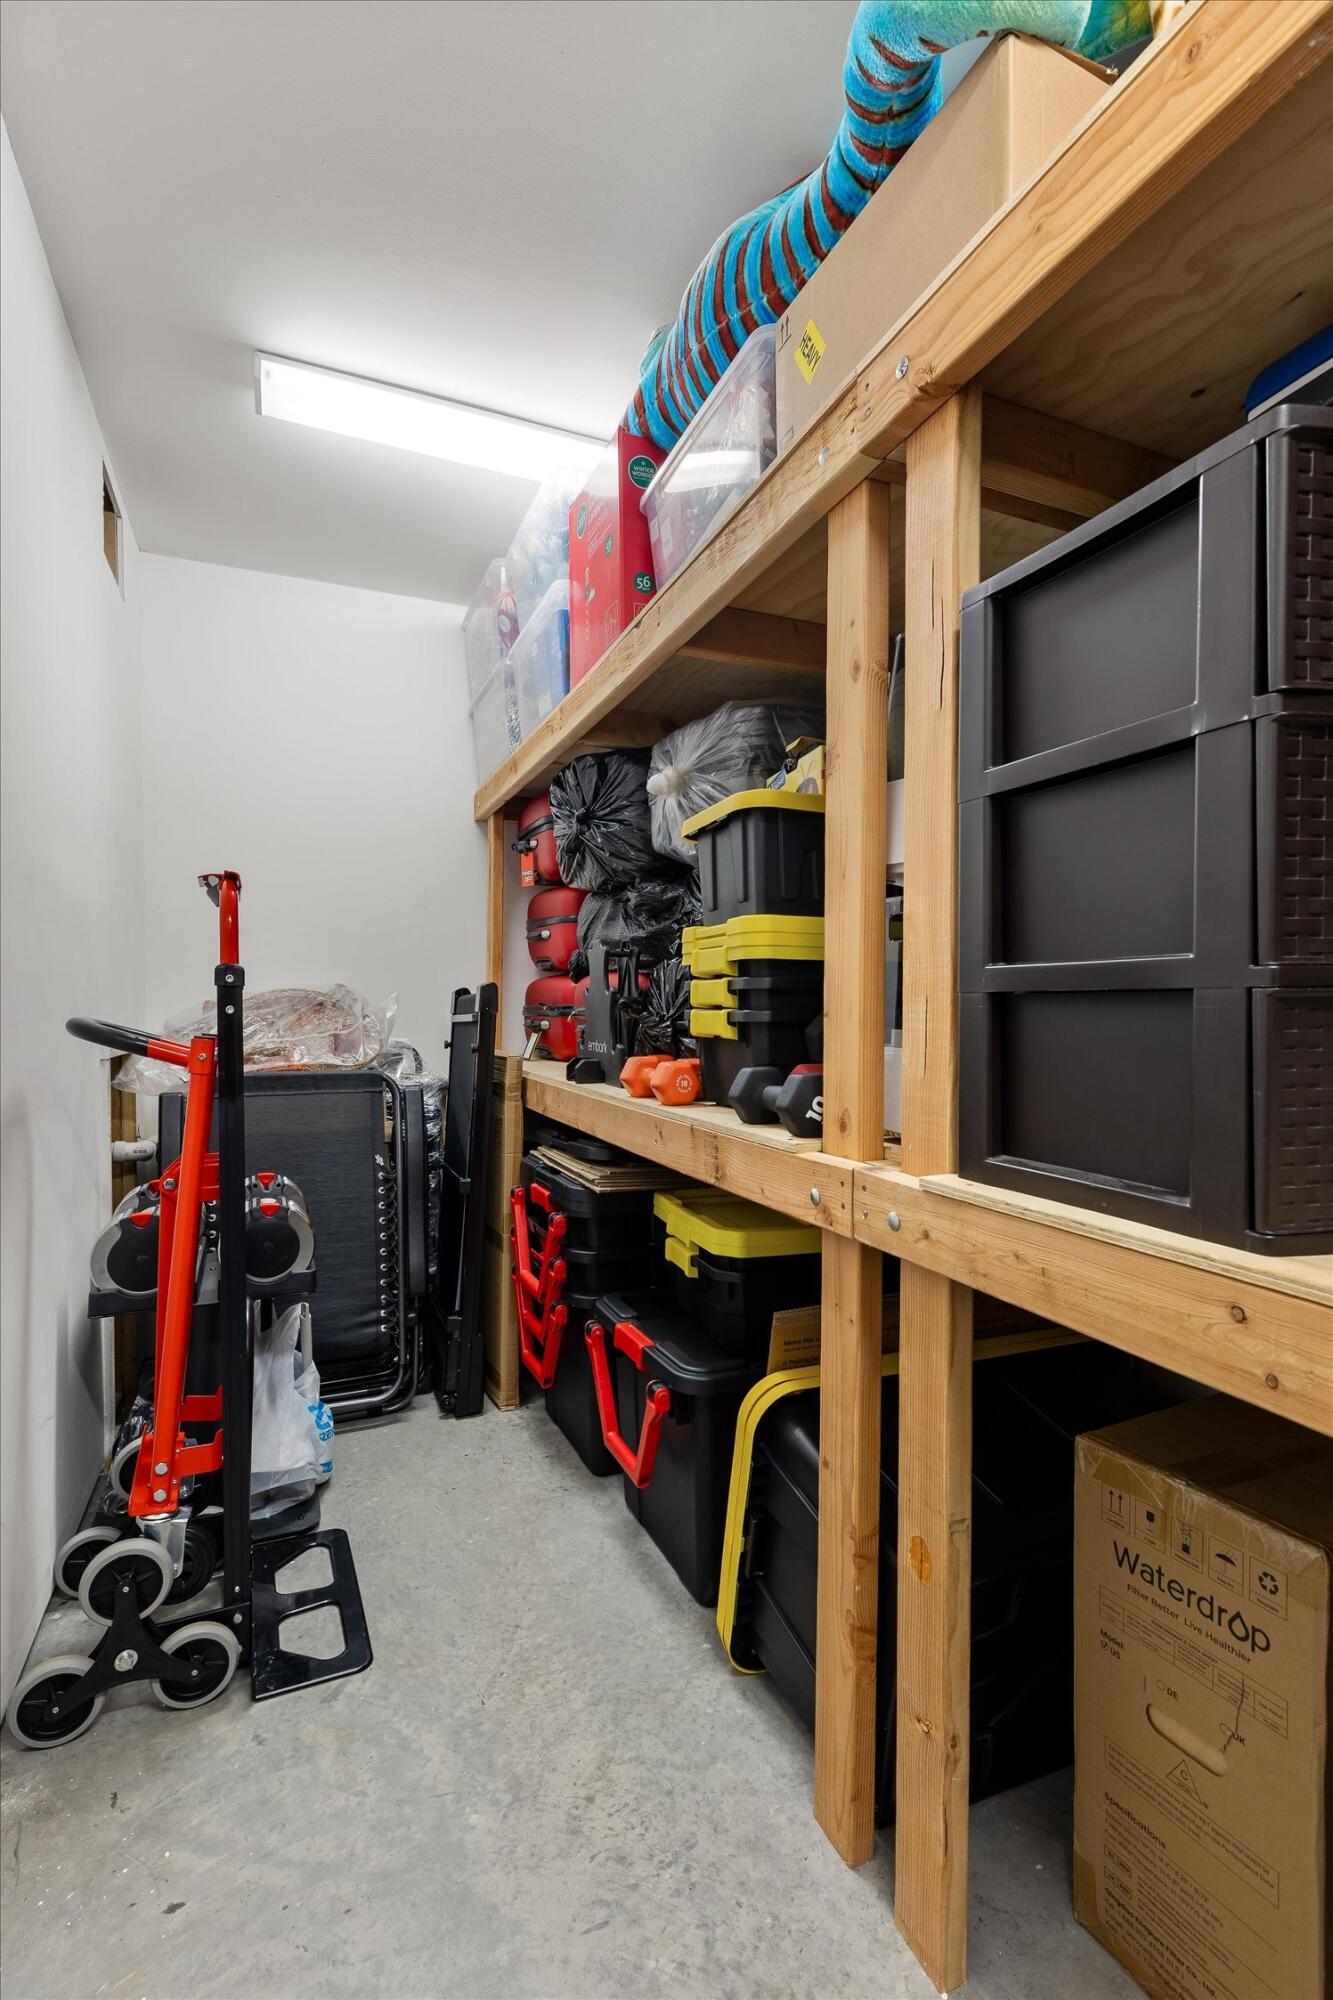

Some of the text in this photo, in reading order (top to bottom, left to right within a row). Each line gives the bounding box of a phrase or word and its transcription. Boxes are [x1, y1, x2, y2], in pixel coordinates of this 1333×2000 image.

[799, 329, 821, 372] HEAVY
[637, 576, 651, 589] 56
[805, 1096, 824, 1121] 10
[1113, 1540, 1271, 1653] Waterdrop
[1127, 1584, 1149, 1602] Filter
[1152, 1599, 1180, 1621] Better
[1184, 1617, 1203, 1635] Live
[1206, 1632, 1251, 1664] Healthier
[1167, 1687, 1178, 1700] DE
[1104, 1792, 1166, 1849] Specifications
